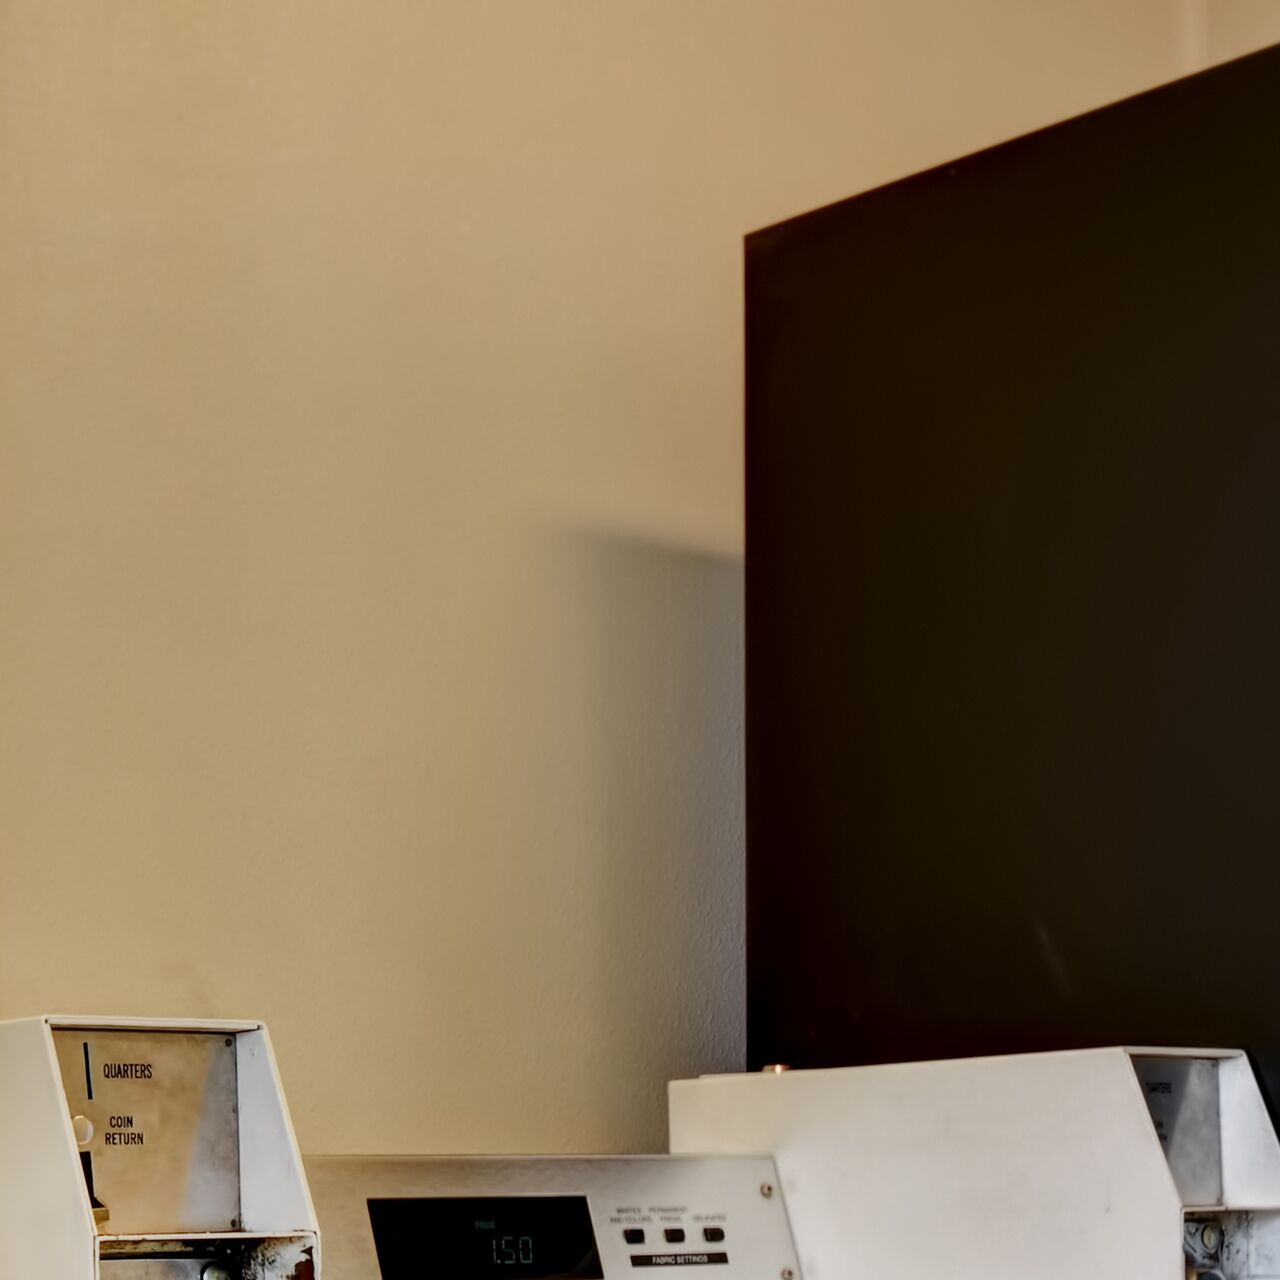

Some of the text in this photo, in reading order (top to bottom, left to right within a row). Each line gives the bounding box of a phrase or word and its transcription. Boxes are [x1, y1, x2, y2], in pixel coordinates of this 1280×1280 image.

[103, 1063, 152, 1079] QUARTERS
[109, 1116, 133, 1128] COIN
[105, 1132, 144, 1145] RETURN
[492, 1236, 533, 1264] 1.50
[652, 1254, 708, 1265] FABRIC SETTINGS
